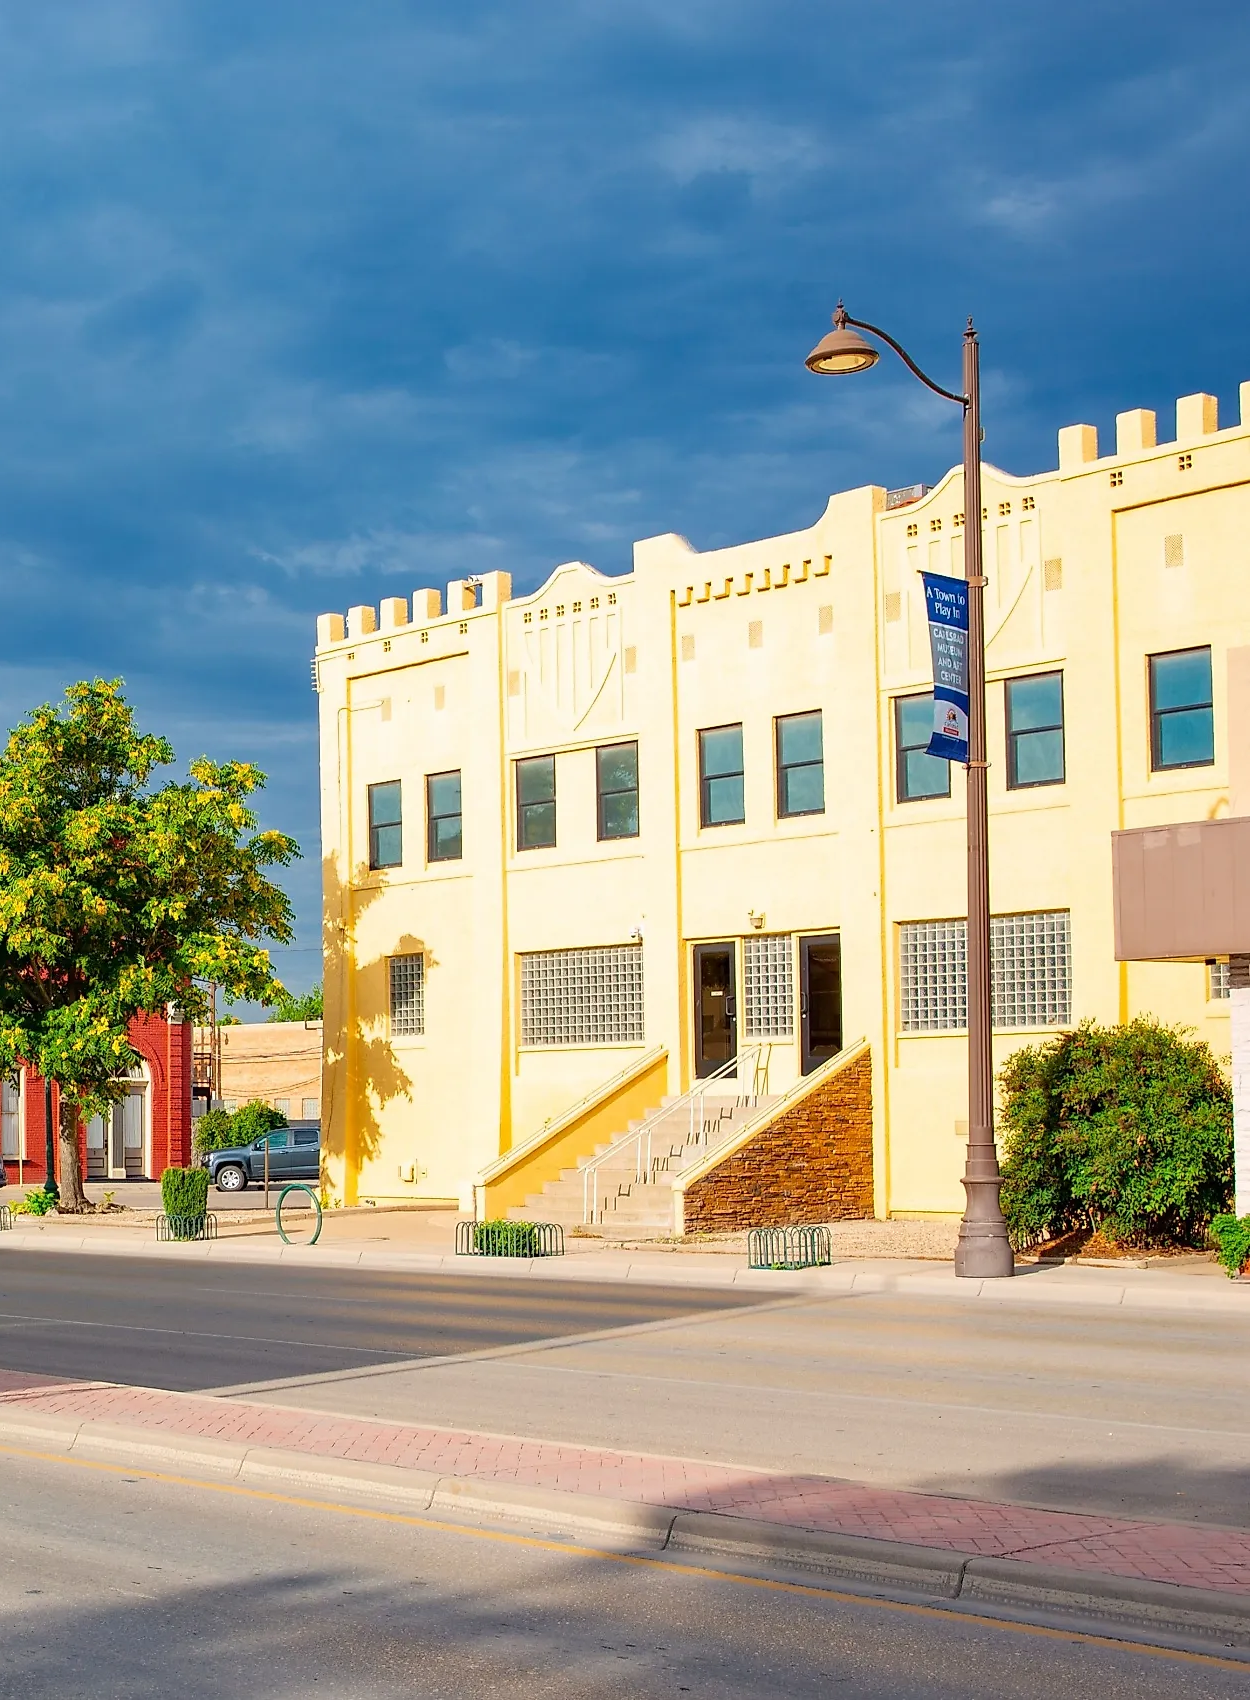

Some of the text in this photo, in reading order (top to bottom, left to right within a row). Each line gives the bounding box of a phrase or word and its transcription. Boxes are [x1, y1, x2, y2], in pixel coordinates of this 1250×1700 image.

[926, 586, 965, 606] A Town to
[934, 602, 961, 620] Play In
[933, 628, 964, 645] CARLSBAD
[937, 644, 963, 658] MUSEUM
[938, 658, 963, 672] AND ART
[940, 670, 962, 686] CENTER
